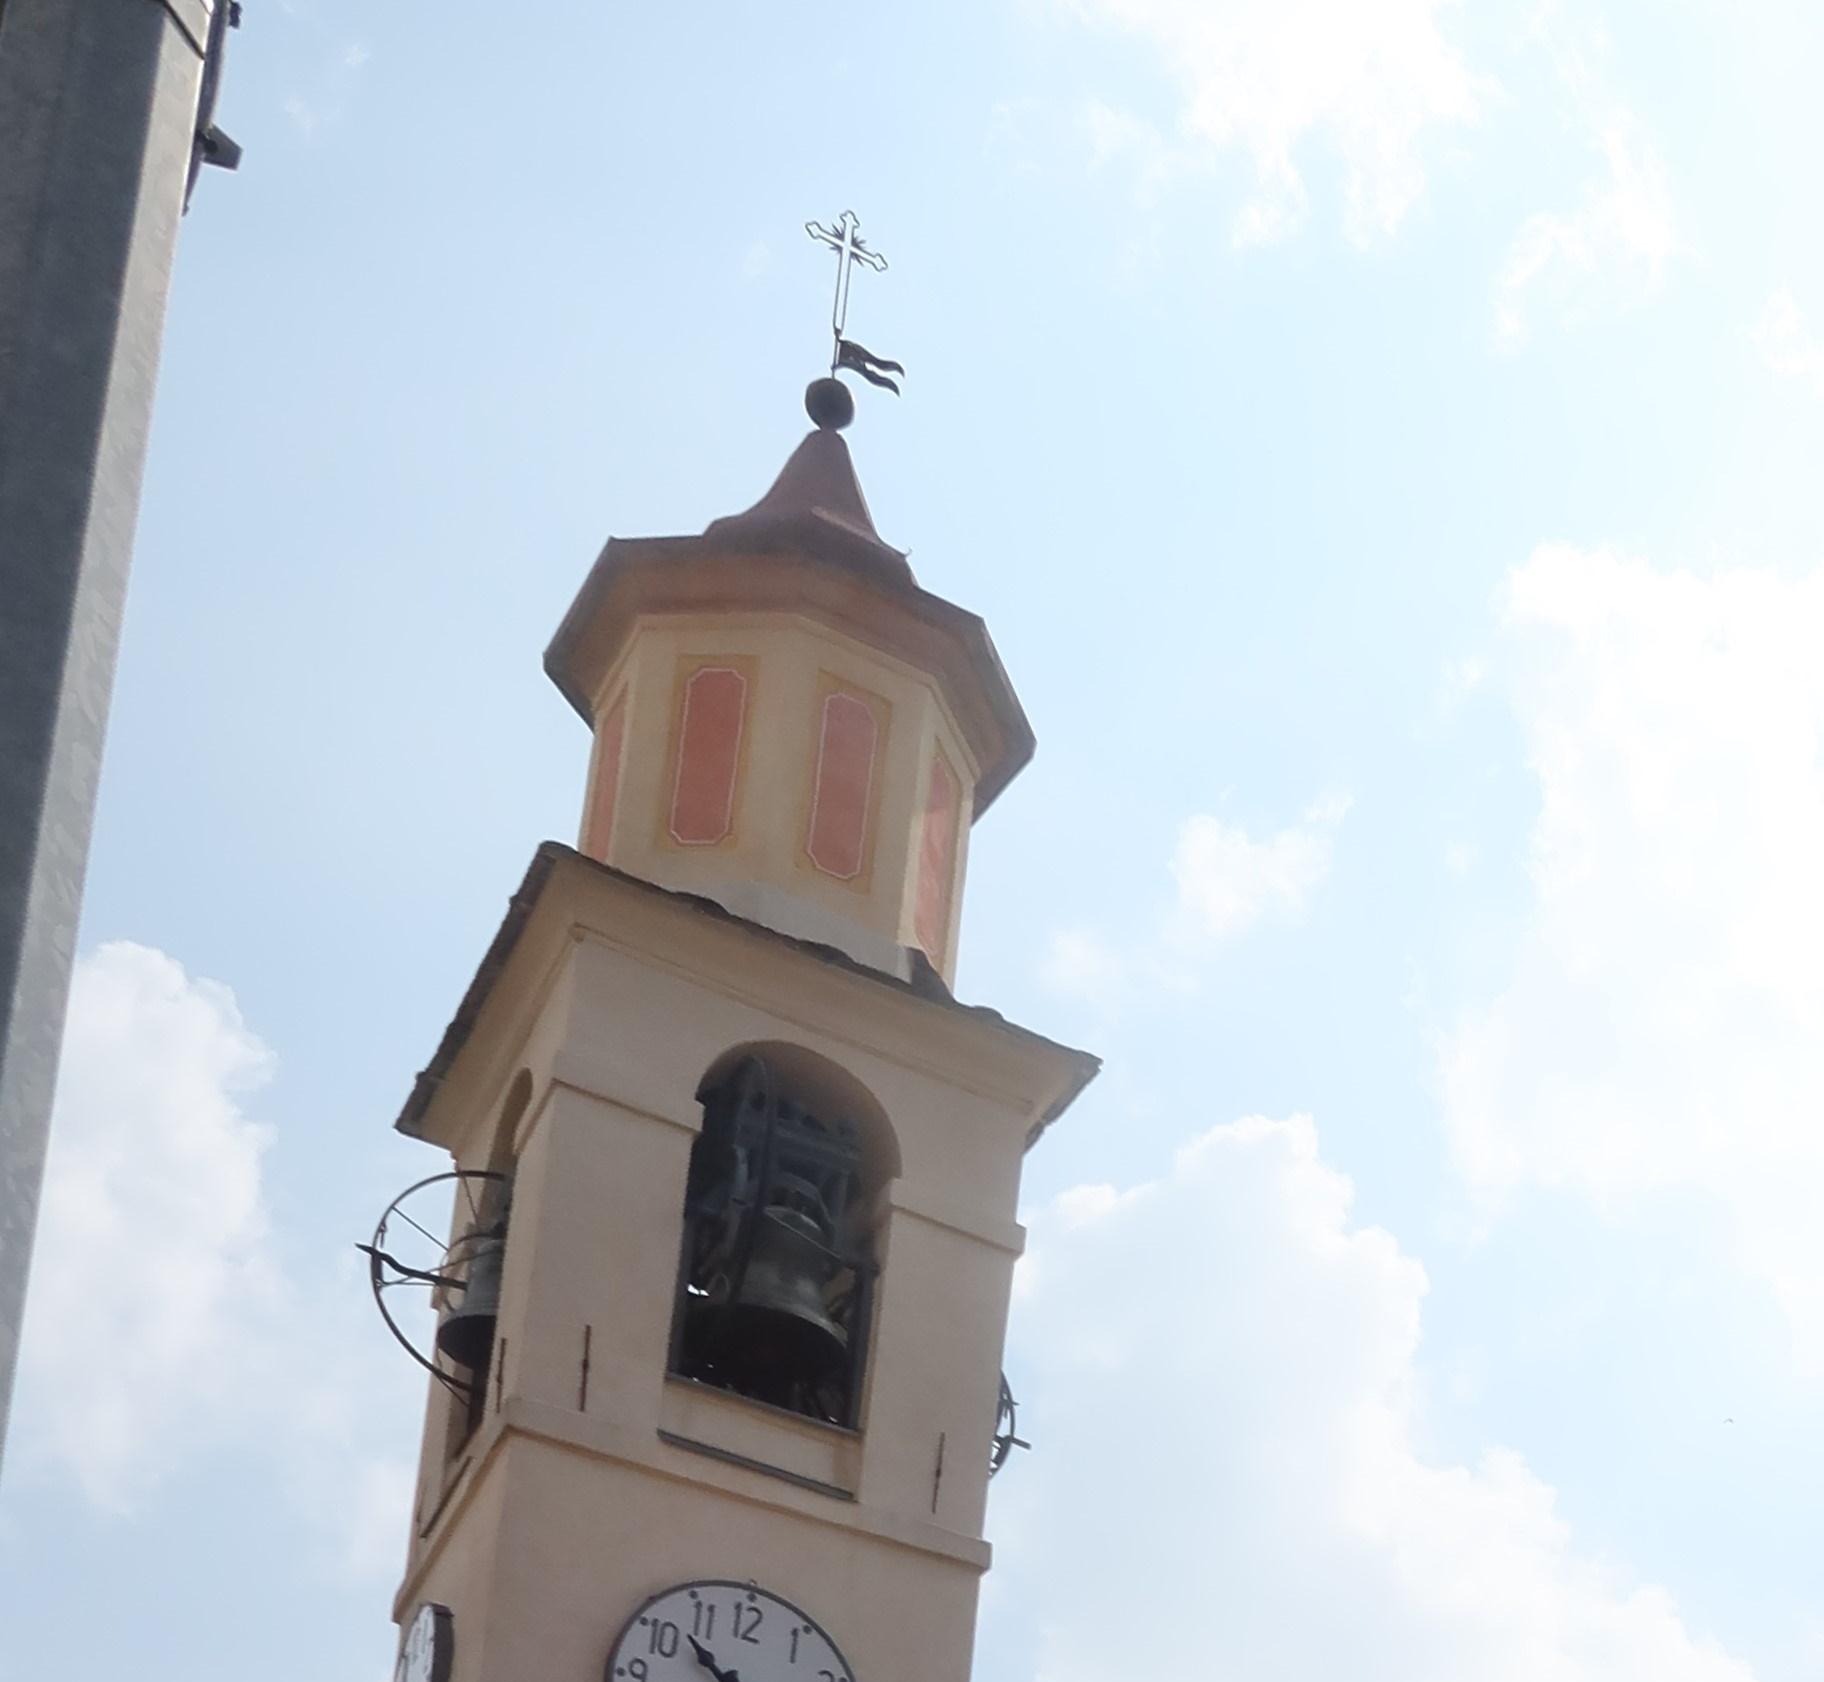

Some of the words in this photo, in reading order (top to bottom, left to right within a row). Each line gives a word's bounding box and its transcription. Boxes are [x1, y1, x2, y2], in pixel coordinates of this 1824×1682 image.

[648, 1617, 680, 1659] 10
[692, 1600, 716, 1641] 11
[732, 1601, 764, 1644] 12
[789, 1627, 800, 1664] 1
